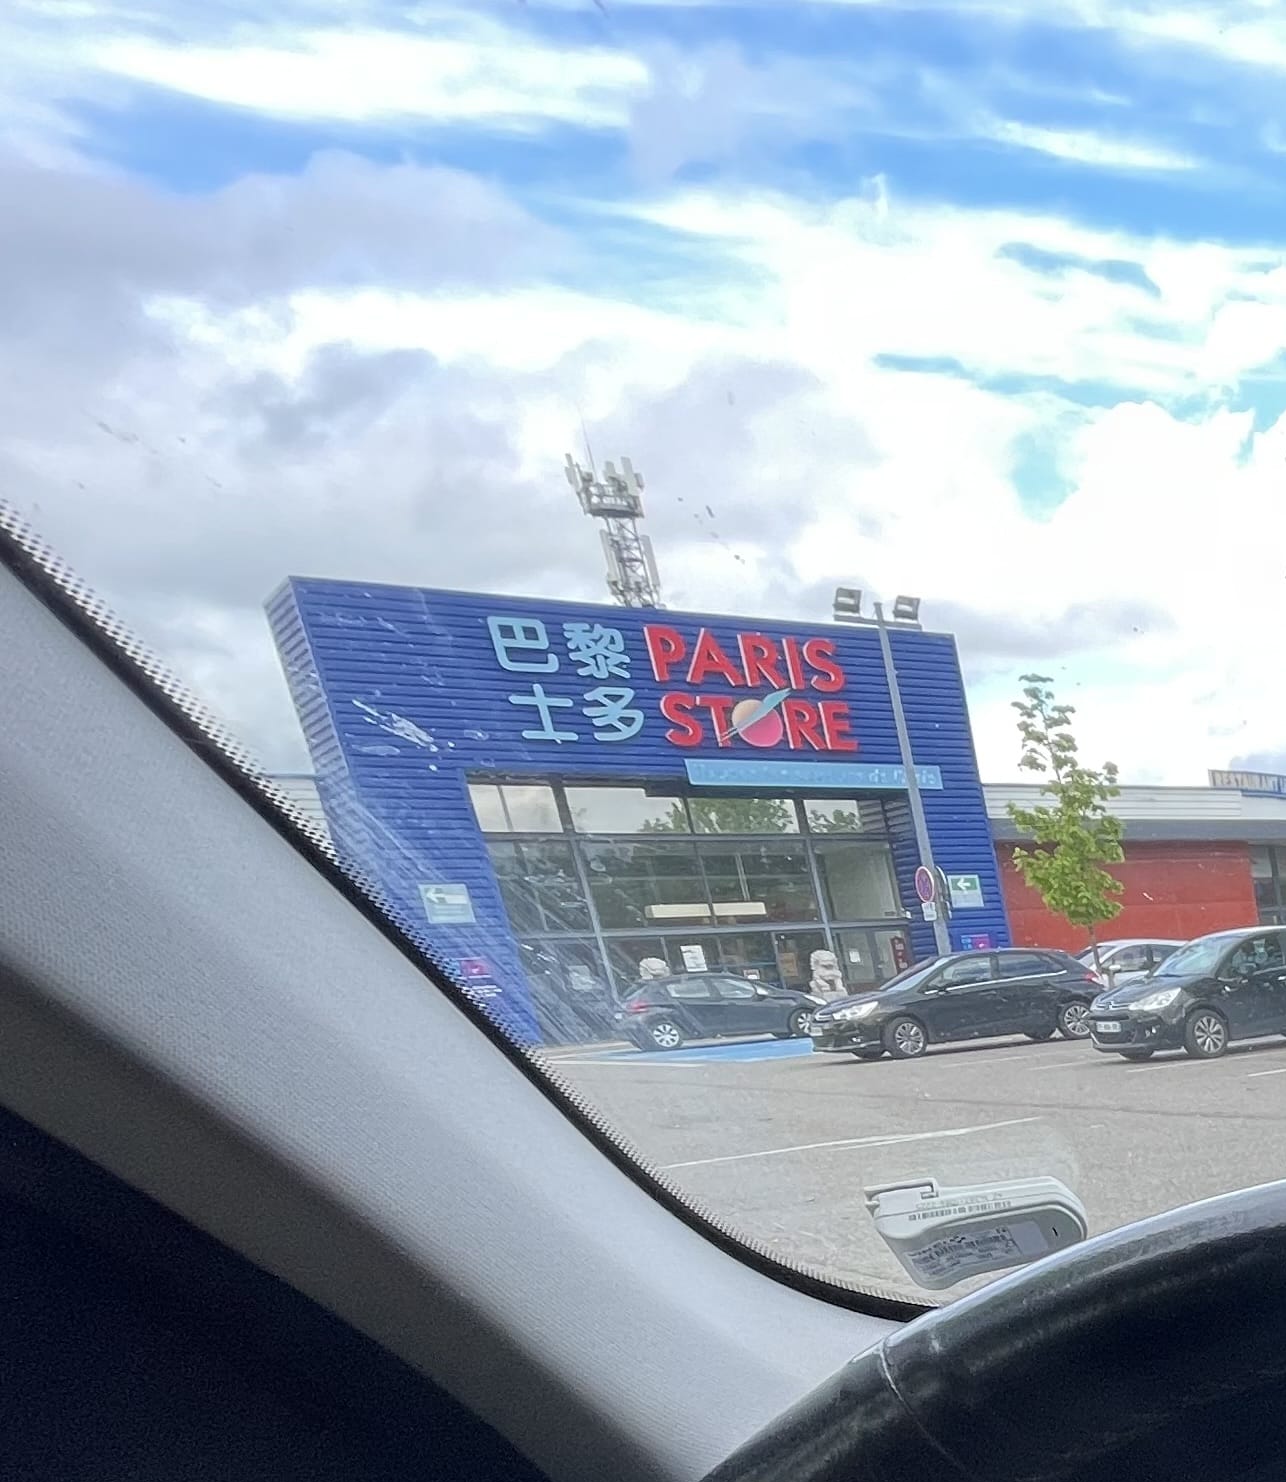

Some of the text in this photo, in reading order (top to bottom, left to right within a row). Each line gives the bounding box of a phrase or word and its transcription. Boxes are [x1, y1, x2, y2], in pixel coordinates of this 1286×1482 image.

[486, 616, 631, 679] 巴黎
[643, 624, 845, 692] PARIS
[508, 683, 644, 744] 士多
[660, 690, 858, 751] STORE
